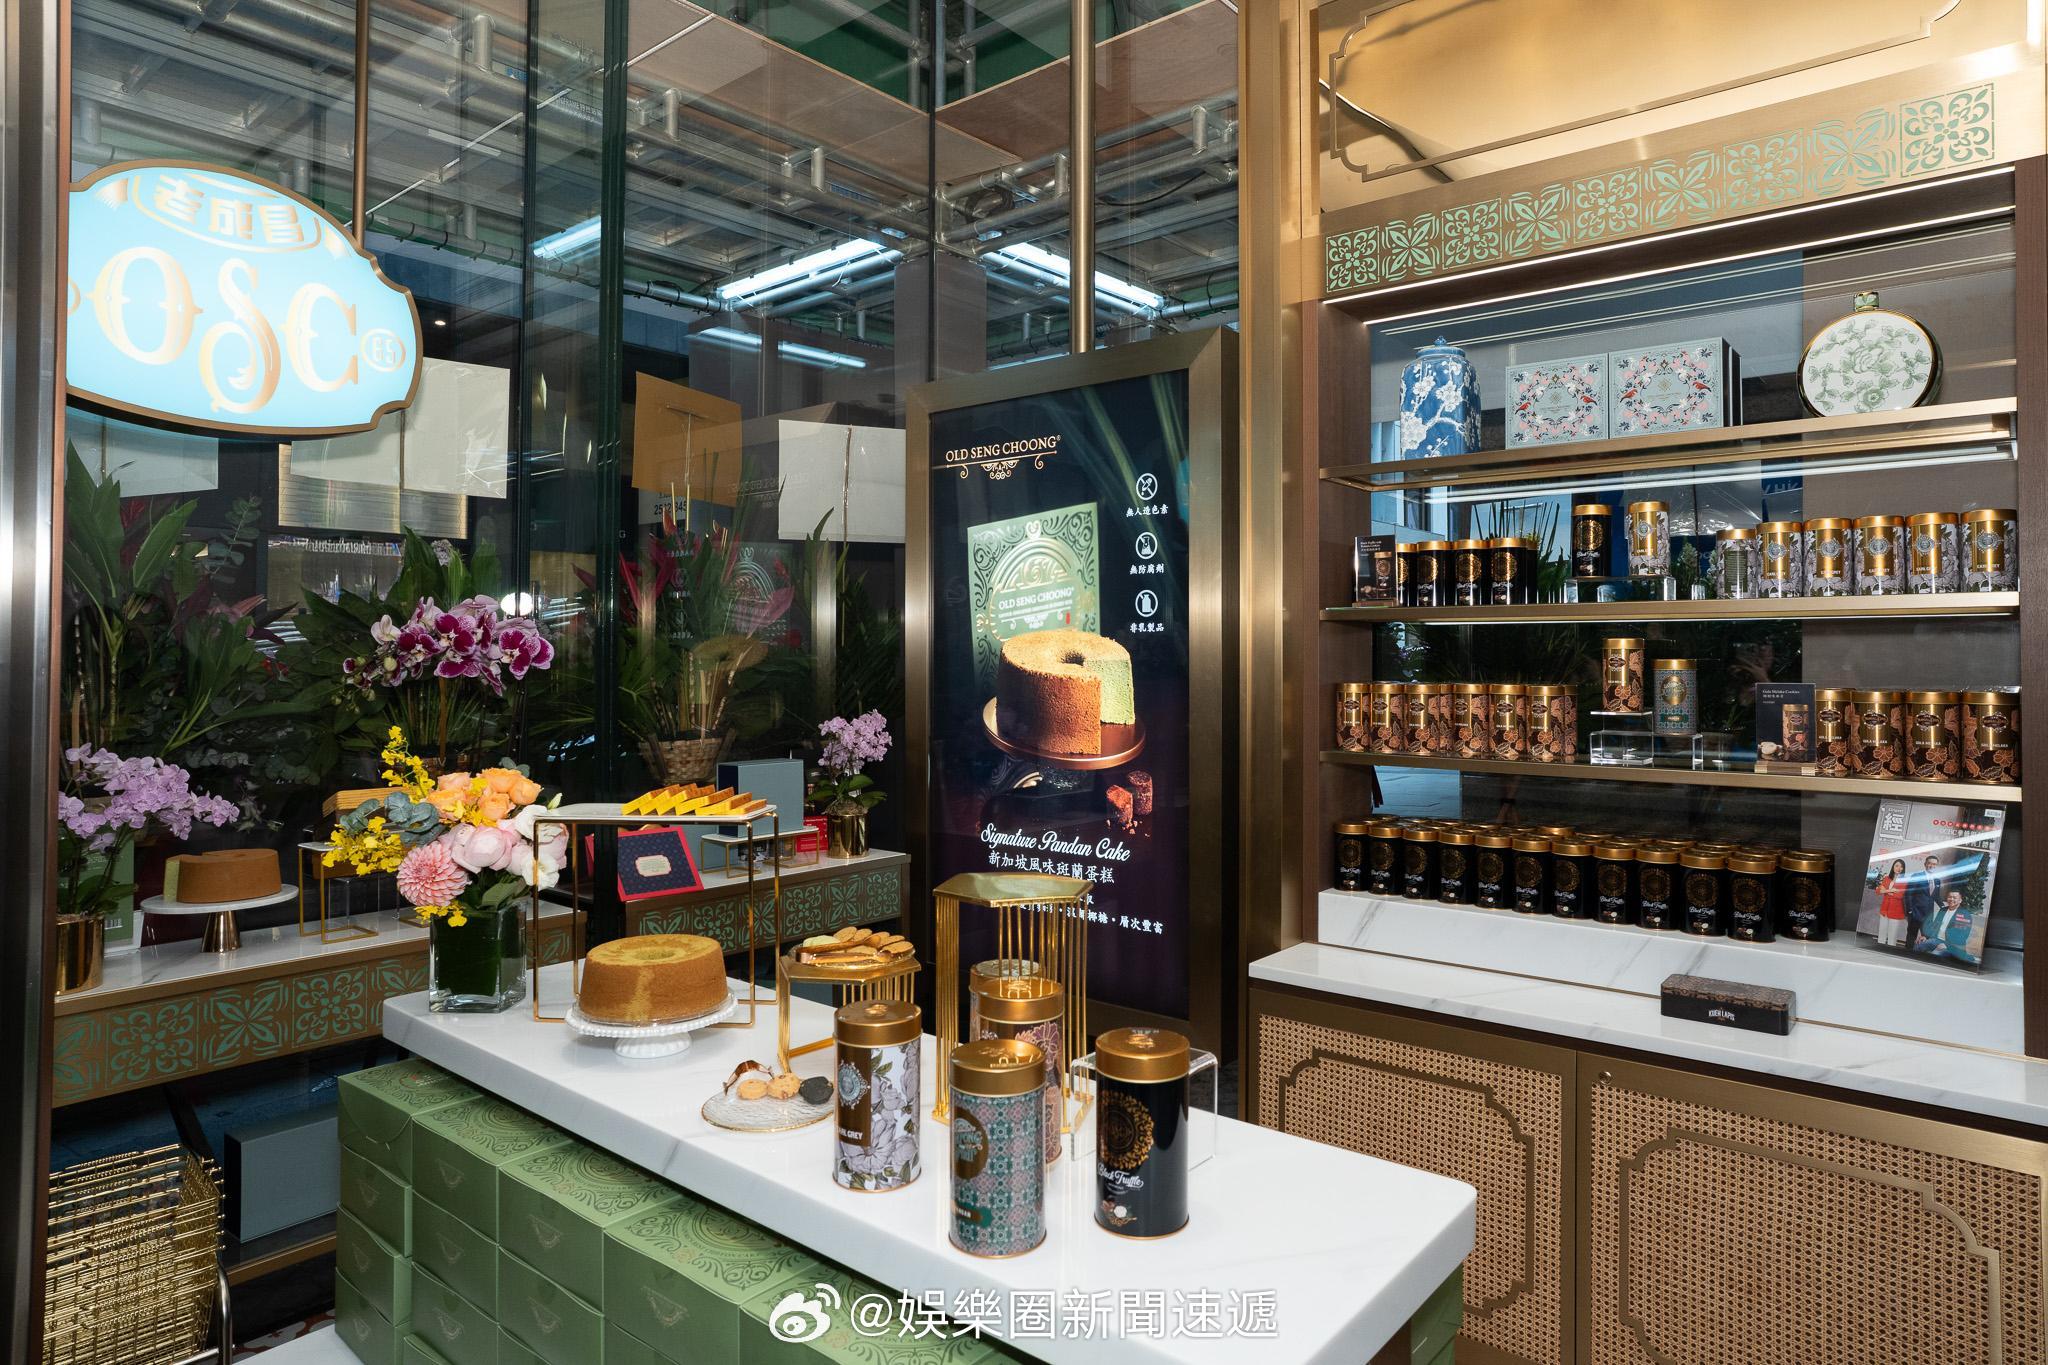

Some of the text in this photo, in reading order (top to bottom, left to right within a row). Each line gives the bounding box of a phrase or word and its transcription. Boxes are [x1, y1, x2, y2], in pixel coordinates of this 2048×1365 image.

[84, 246, 359, 414] OSC
[945, 449, 969, 462] OLD
[970, 444, 1000, 458] SENG
[1125, 503, 1169, 518] 無人造色素
[998, 598, 1015, 610] OLD
[1016, 594, 1037, 607] SENG
[980, 822, 1131, 862] Signature Pandan Cake
[988, 850, 1115, 884] 新加坡風味斑蘭蛋糕
[1114, 1169, 1145, 1189] Truffle
